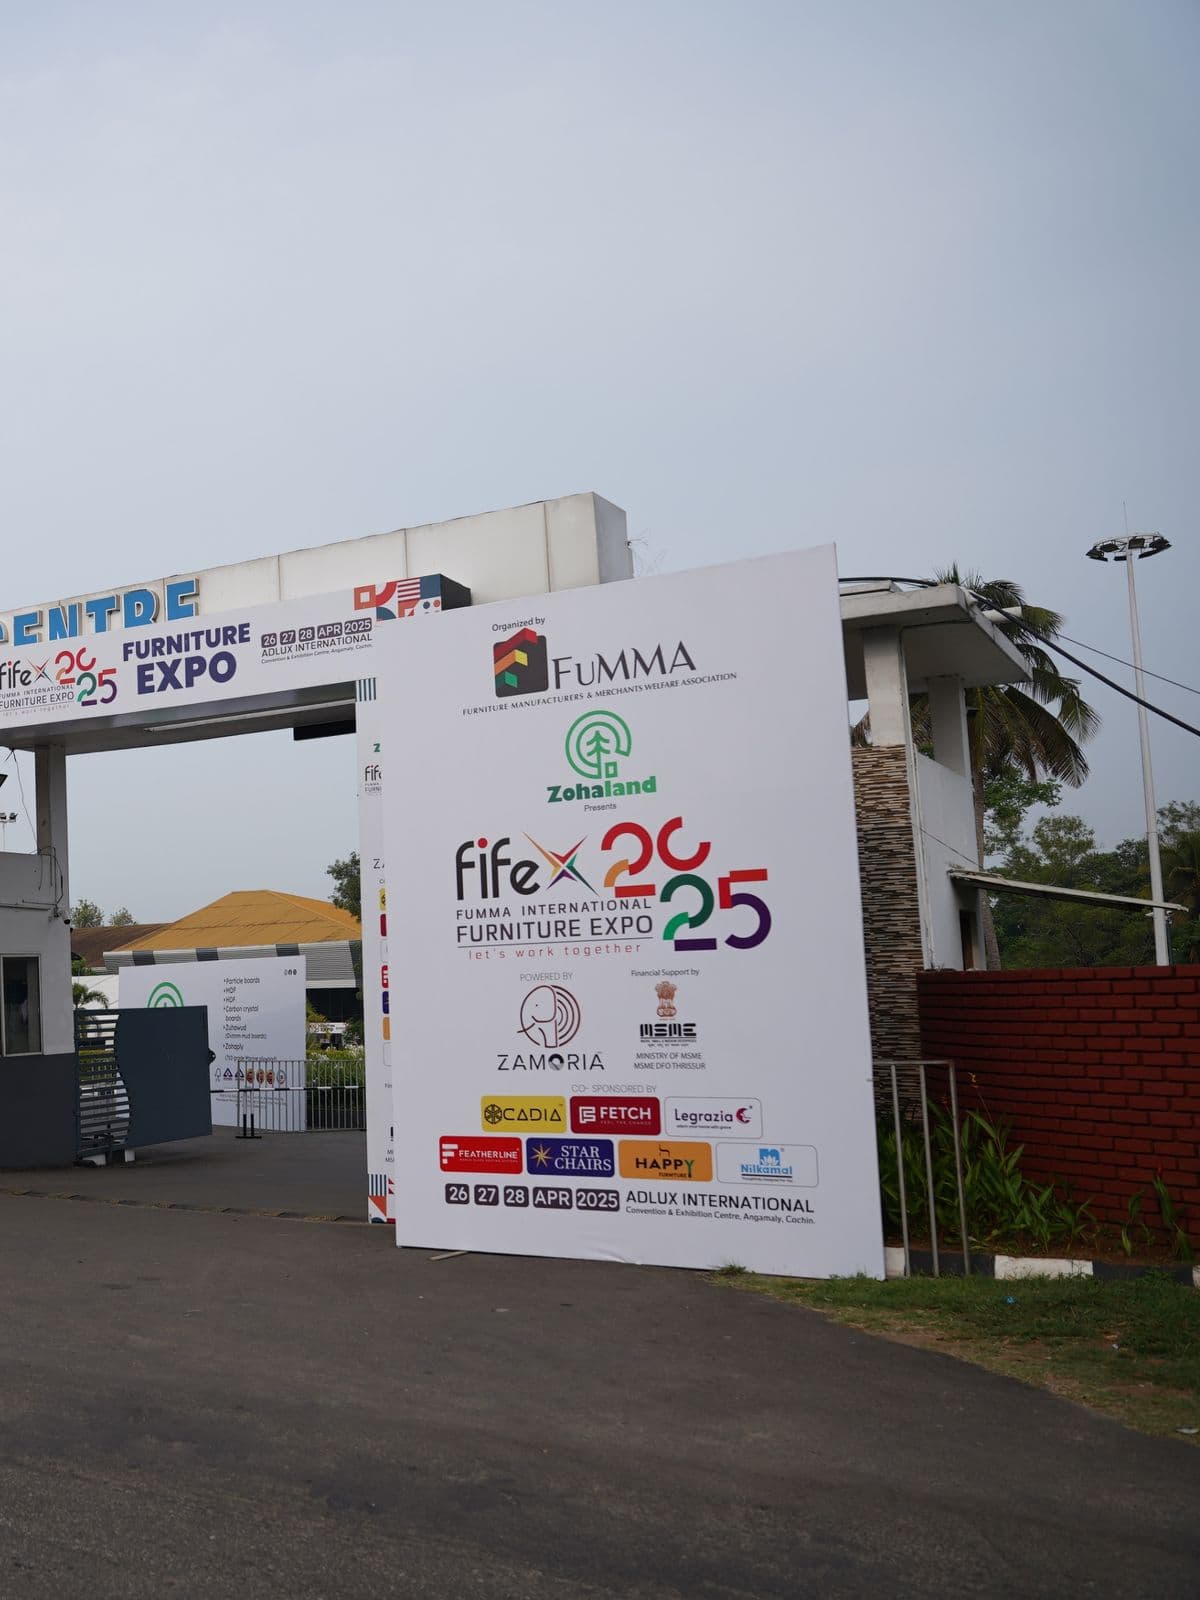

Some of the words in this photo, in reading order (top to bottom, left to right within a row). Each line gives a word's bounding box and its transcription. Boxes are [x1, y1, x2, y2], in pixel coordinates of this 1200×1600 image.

[318, 624, 341, 637] APR
[345, 620, 371, 633] 2025
[491, 617, 534, 632] Organized
[535, 616, 546, 625] by
[123, 622, 250, 661] FURNITURE
[261, 645, 293, 658] ADLUX
[295, 633, 373, 652] INTERNATIONAL
[137, 651, 237, 695] EXPO
[50, 691, 75, 703] EXPO
[462, 703, 508, 715] FURNITURE
[510, 693, 584, 710] MANUFACTURERS
[587, 692, 593, 700] &
[595, 685, 643, 697] MERCHANTS
[644, 680, 680, 690] WELFARE
[681, 672, 737, 686] ASSOCIATION
[546, 775, 657, 803] Zohaland
[584, 802, 617, 811] Presents
[456, 906, 511, 920] FUMMA
[522, 898, 652, 916] INTERNATIONAL
[456, 919, 582, 943] FURNITURE
[590, 915, 653, 937] EXPO
[468, 948, 506, 960] let's
[515, 948, 554, 958] work
[564, 943, 641, 957] together
[520, 972, 560, 981] POWERED
[562, 971, 574, 980] BY
[662, 969, 689, 977] Support
[497, 1053, 605, 1071] ZAMORIA
[636, 1052, 668, 1060] MINISTRY
[669, 1052, 679, 1060] OF
[681, 1052, 702, 1060] MSME
[634, 1062, 655, 1070] MSME
[656, 1062, 671, 1070] DFO
[672, 1062, 706, 1070] THRISSUR
[592, 1084, 644, 1093] SPONSORED
[646, 1085, 657, 1093] BY
[600, 1106, 651, 1120] FETCH
[674, 1108, 733, 1125] Legrazia
[458, 1150, 518, 1159] FEATHERLINE
[561, 1145, 600, 1158] STAR
[554, 1158, 612, 1171] CHAIRS
[635, 1158, 695, 1178] HAPPY
[740, 1164, 793, 1175] Nilkamal
[449, 1186, 468, 1201] 26
[477, 1188, 496, 1202] 27
[505, 1189, 525, 1204] 28
[534, 1190, 570, 1206] APR
[576, 1191, 618, 1208] 2025
[626, 1190, 677, 1205] ADLUX
[683, 1193, 815, 1213] INTERNATIONAL
[625, 1206, 667, 1215] Convention
[676, 1208, 713, 1219] Exhibition
[714, 1211, 742, 1221] Centre,
[743, 1213, 784, 1224] Angamaly,
[785, 1216, 816, 1225] Cochin.
